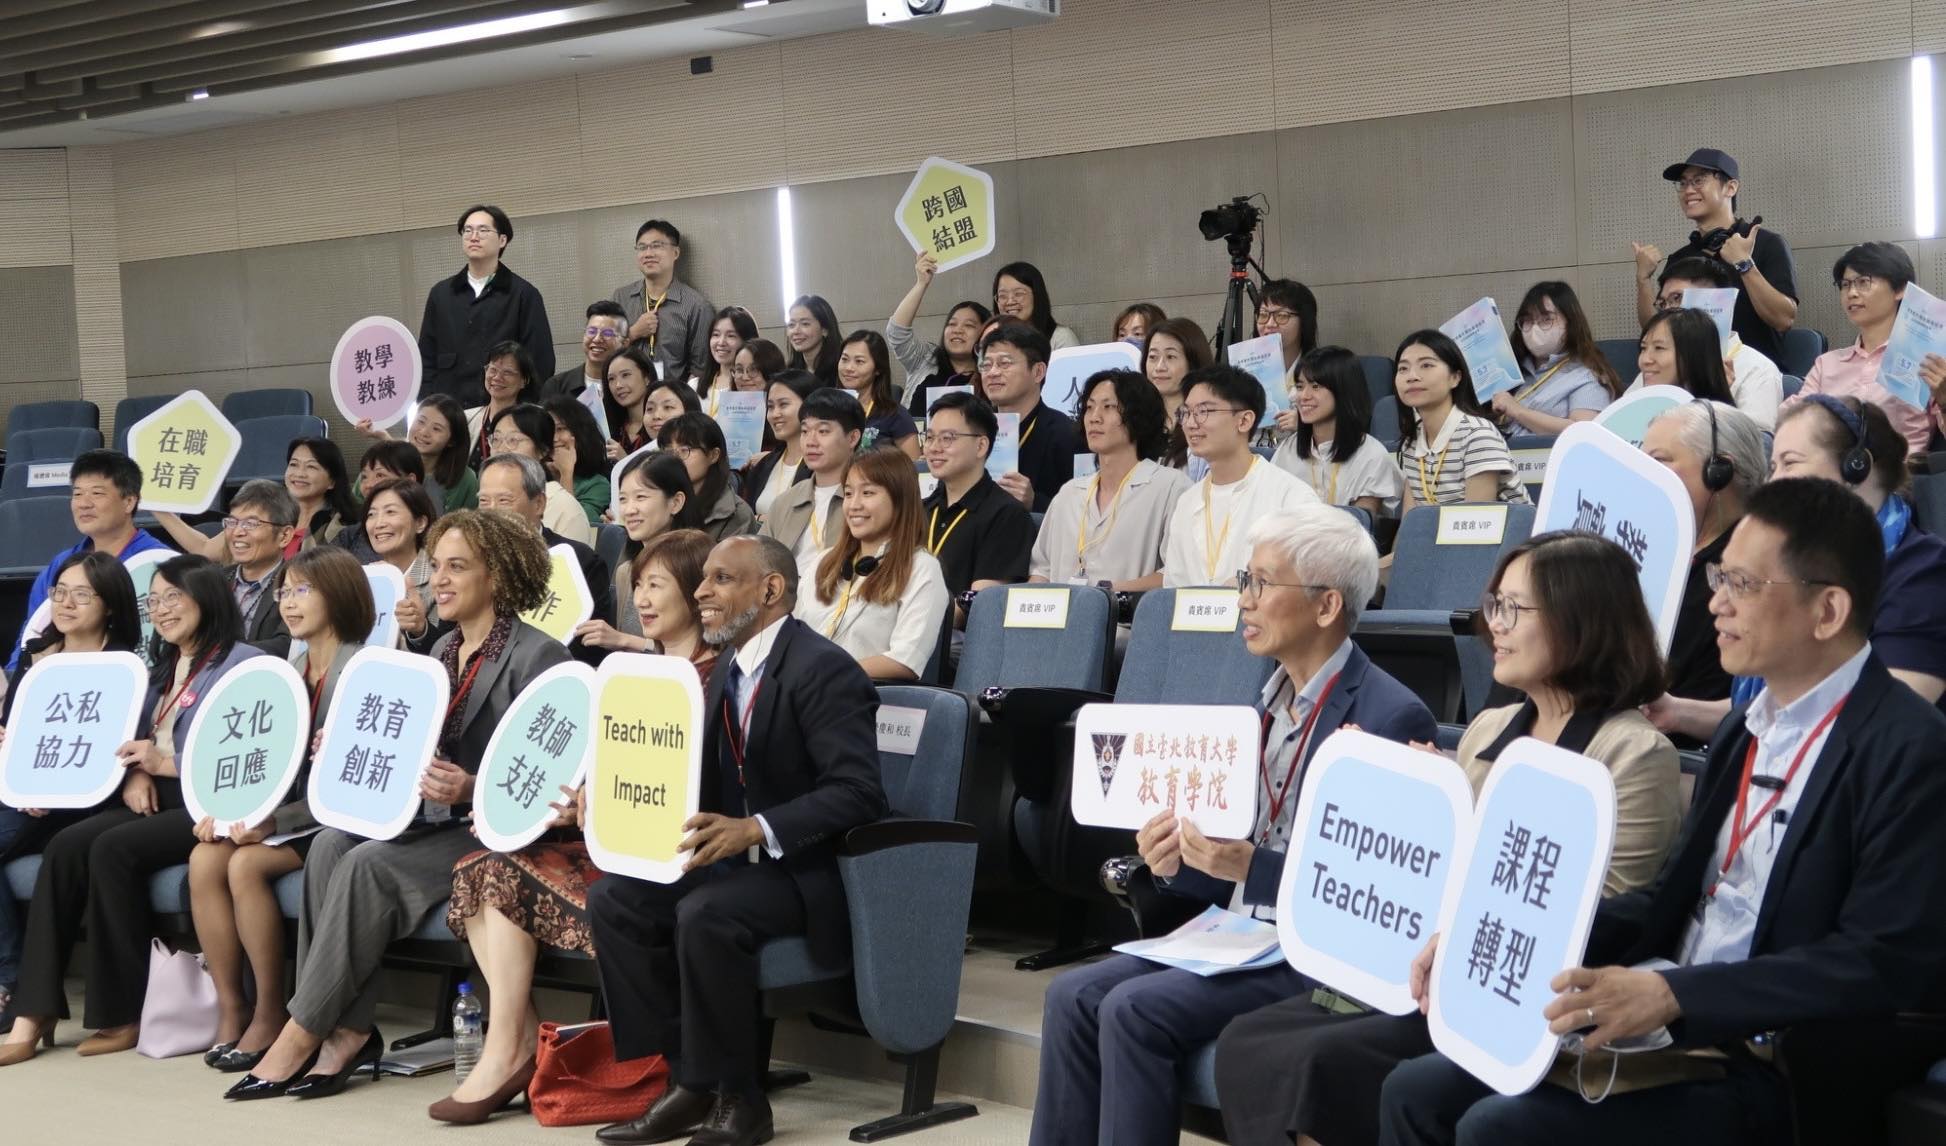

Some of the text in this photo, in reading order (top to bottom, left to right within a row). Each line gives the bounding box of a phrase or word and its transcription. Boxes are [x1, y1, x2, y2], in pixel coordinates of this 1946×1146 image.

[922, 185, 967, 222] 跨國
[932, 216, 977, 252] 結盟
[354, 344, 393, 373] 教學
[357, 375, 396, 404] 教練
[158, 426, 208, 456] 在職
[150, 461, 201, 490] 培育
[1534, 462, 1546, 470] VIP
[1478, 520, 1492, 530] VIP
[1043, 603, 1056, 613] VIP
[1213, 606, 1228, 616] VIP
[44, 690, 102, 724] 公私
[218, 700, 273, 744] 文化
[355, 692, 411, 740] 教育
[526, 703, 577, 759] 教師
[603, 714, 684, 750] Teach with
[33, 735, 93, 769] 協力
[214, 747, 269, 793] 回應
[340, 744, 396, 793] 創新
[496, 754, 546, 809] 支持
[614, 774, 666, 809] Impact
[1137, 764, 1228, 812] 教育學院
[1319, 801, 1441, 878] Empower
[1490, 819, 1562, 910] 課程
[1311, 861, 1423, 940] Teachers
[1467, 911, 1537, 1007] 轉型
